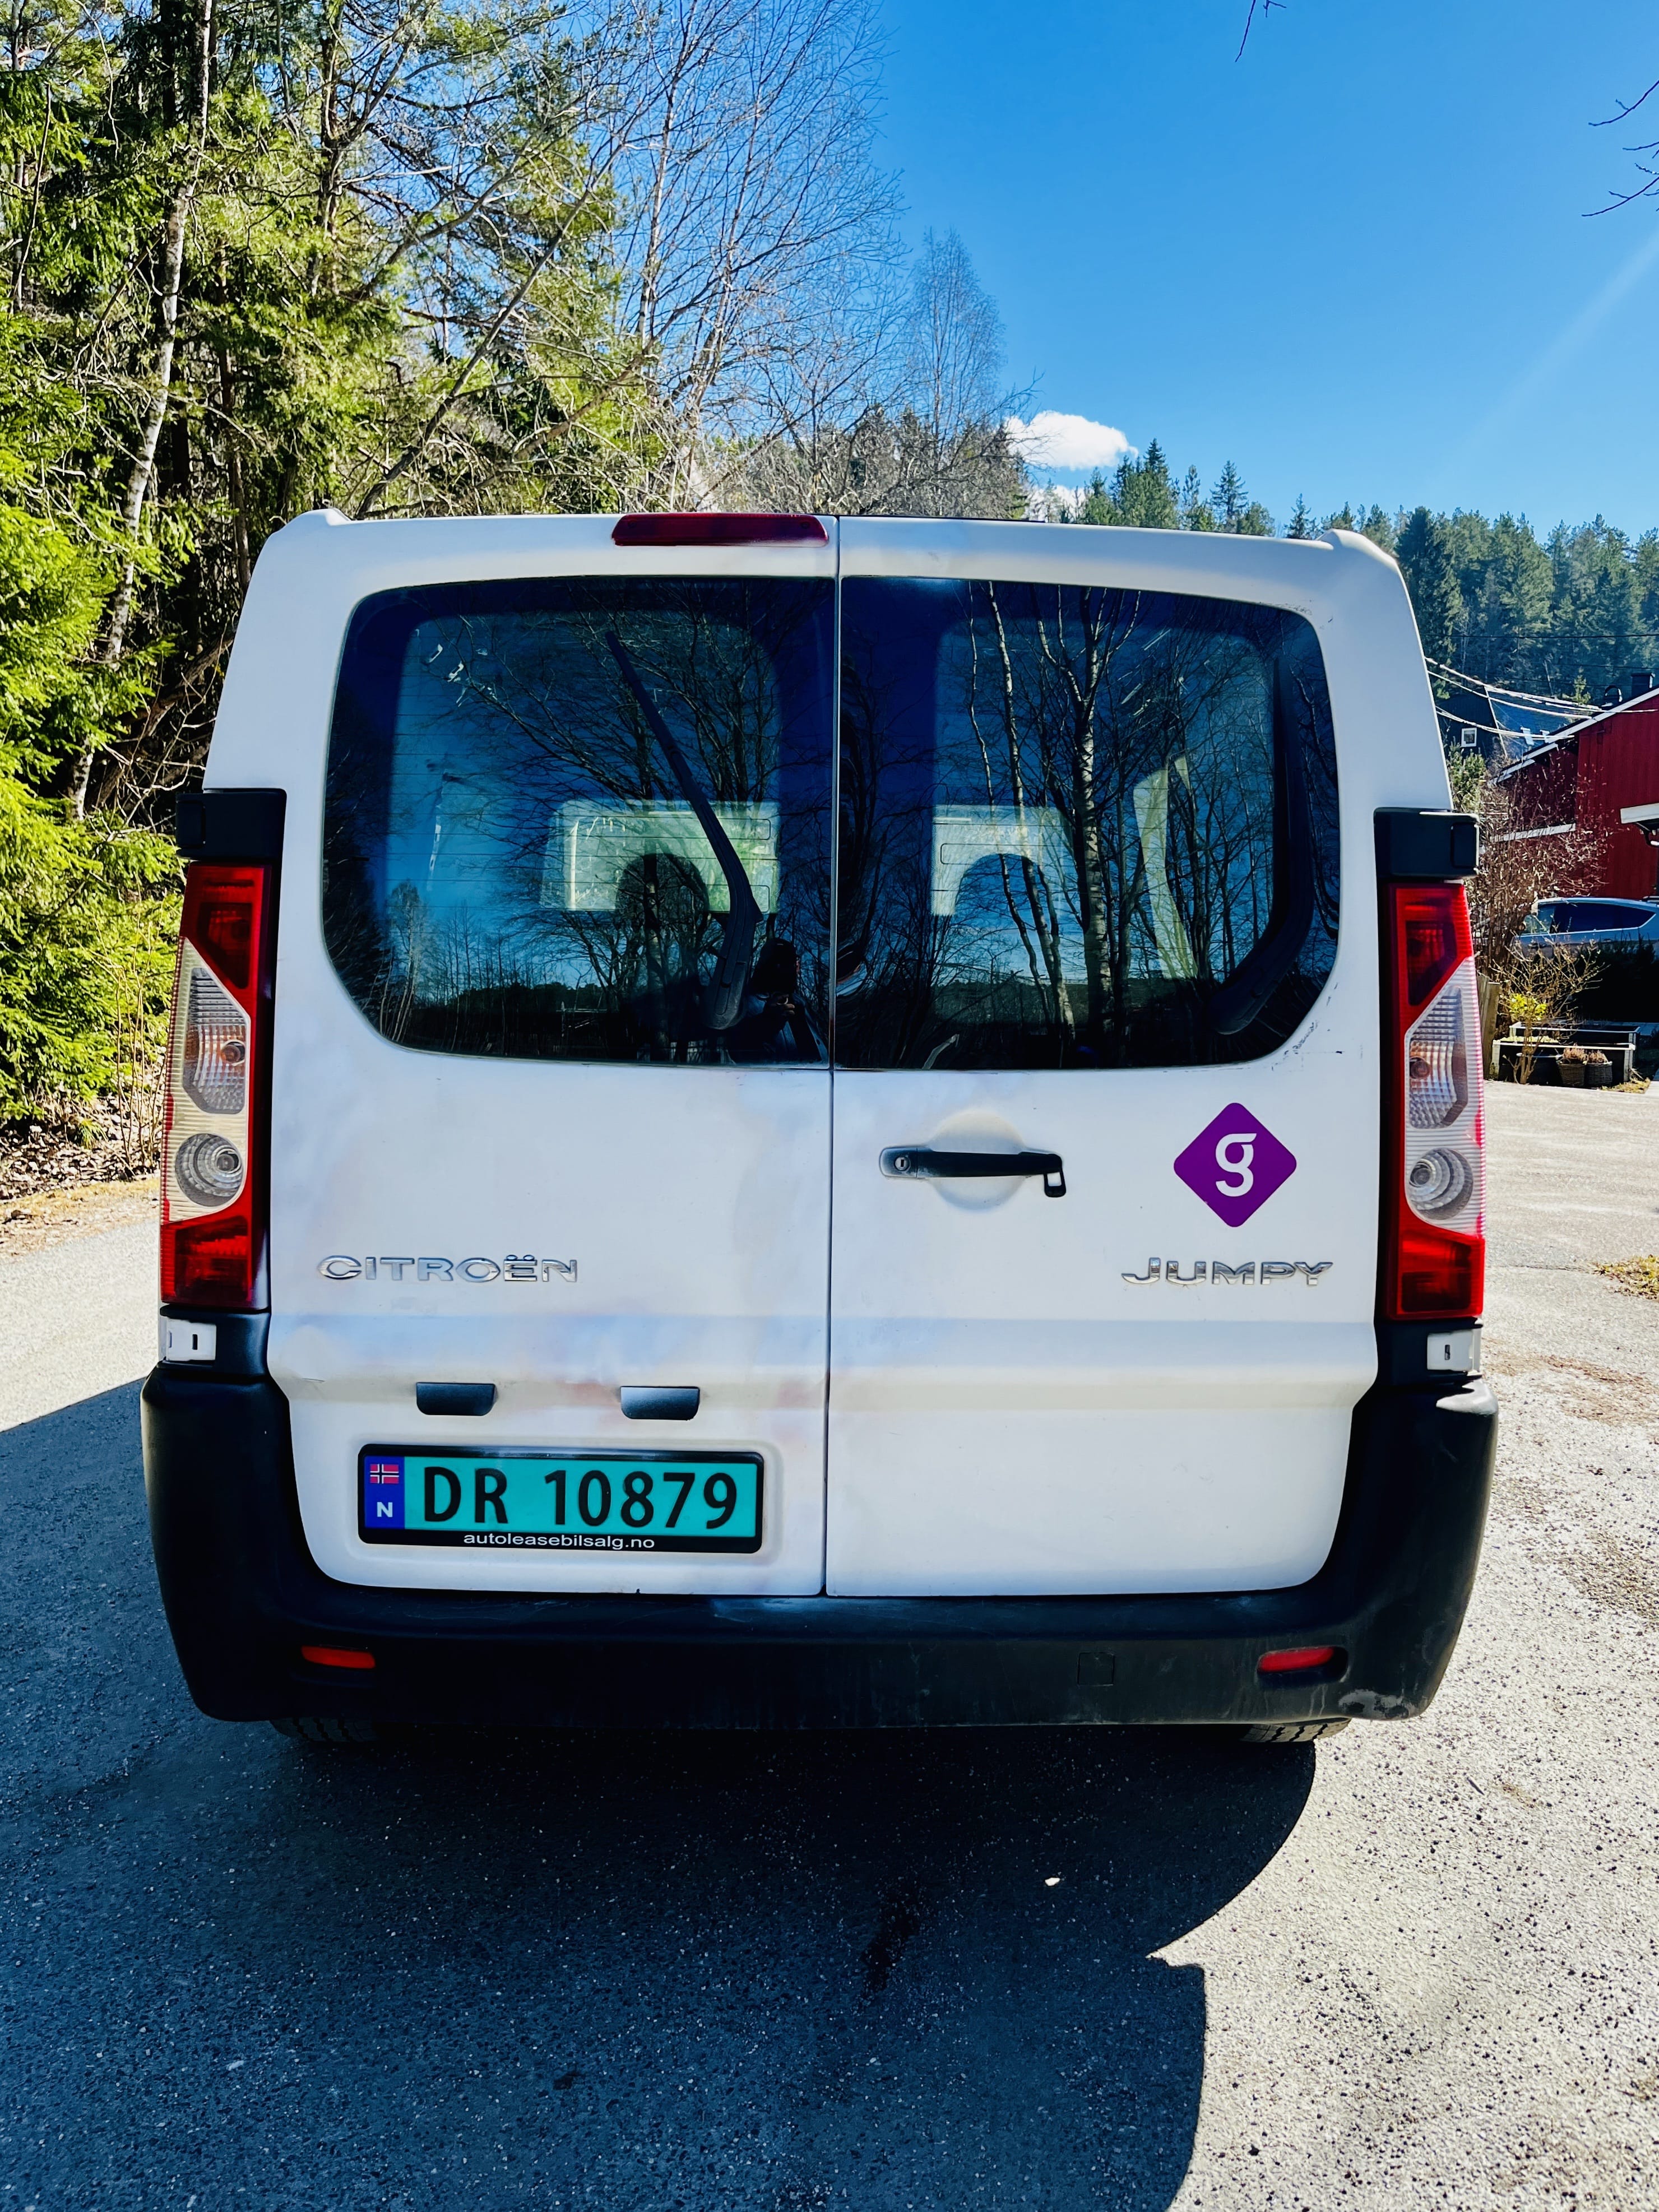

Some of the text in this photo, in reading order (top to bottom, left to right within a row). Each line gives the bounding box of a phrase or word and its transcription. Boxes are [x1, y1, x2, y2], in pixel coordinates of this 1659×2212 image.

[1215, 1133, 1257, 1197] g
[317, 1254, 578, 1283] CITROËN
[1121, 1257, 1334, 1286] JUMPY
[377, 1501, 393, 1518] N
[424, 1466, 737, 1529] DR 10879
[463, 1533, 655, 1551] autoleasebilsalg.no
